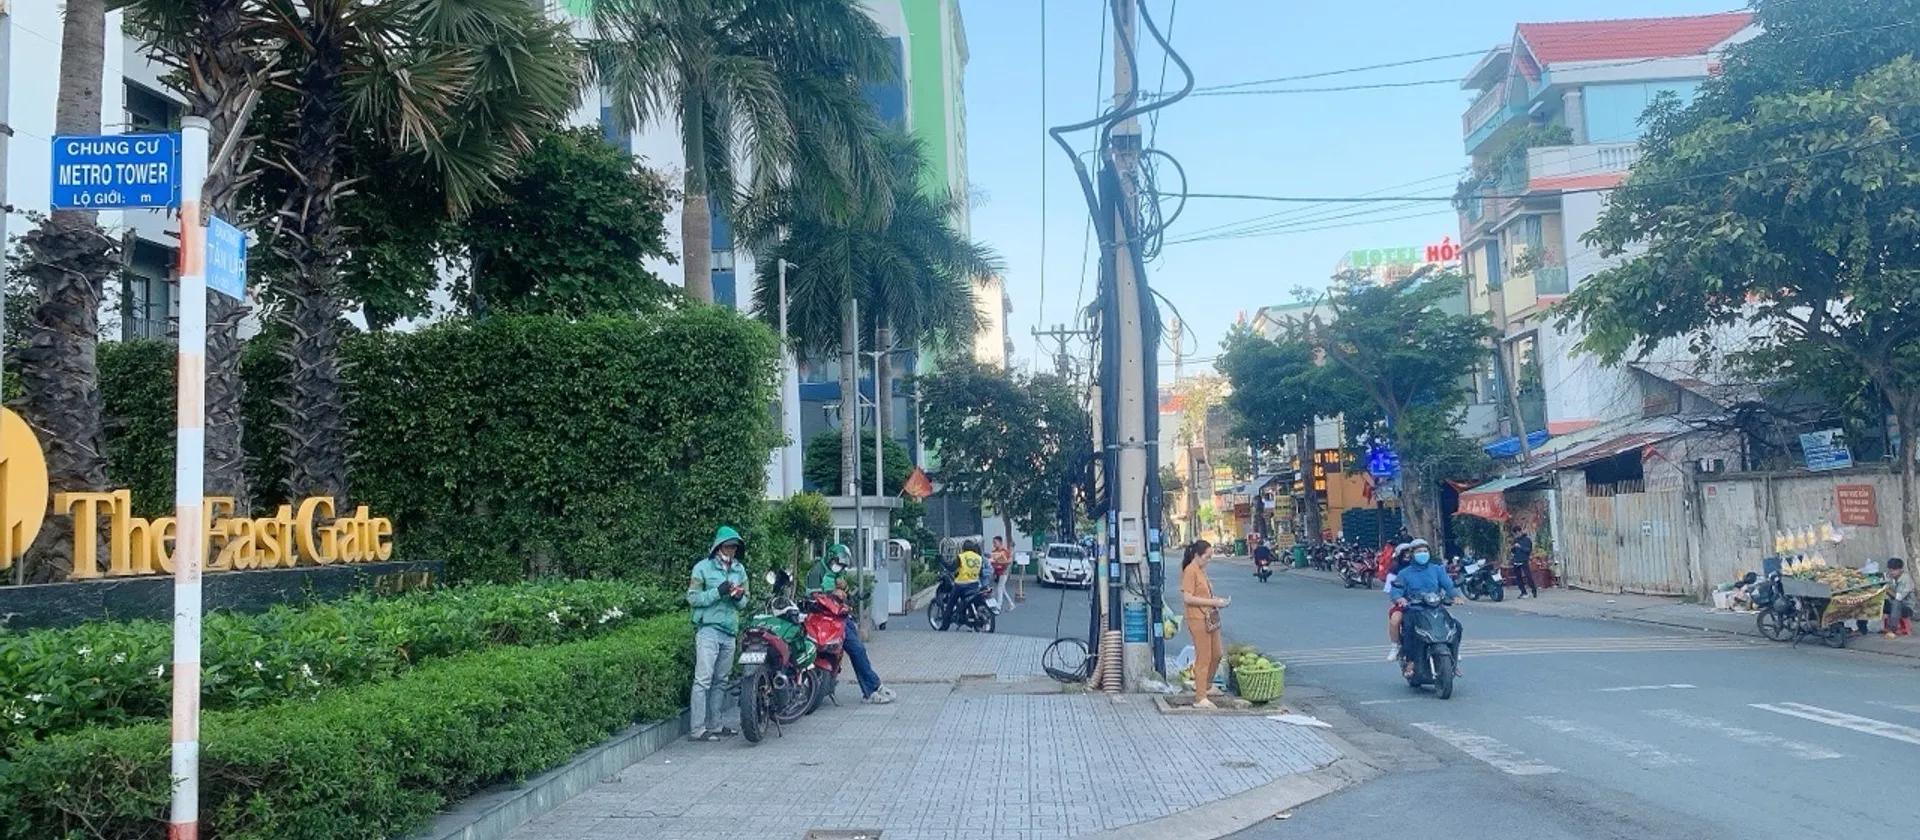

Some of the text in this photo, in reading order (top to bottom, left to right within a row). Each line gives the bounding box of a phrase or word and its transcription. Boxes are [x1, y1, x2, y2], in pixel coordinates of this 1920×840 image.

[67, 138, 161, 155] CHUNG CƯ
[59, 161, 168, 186] METRO TOWER
[73, 191, 91, 208] LỘ
[140, 194, 152, 203] m
[54, 489, 394, 579] The East Gate
